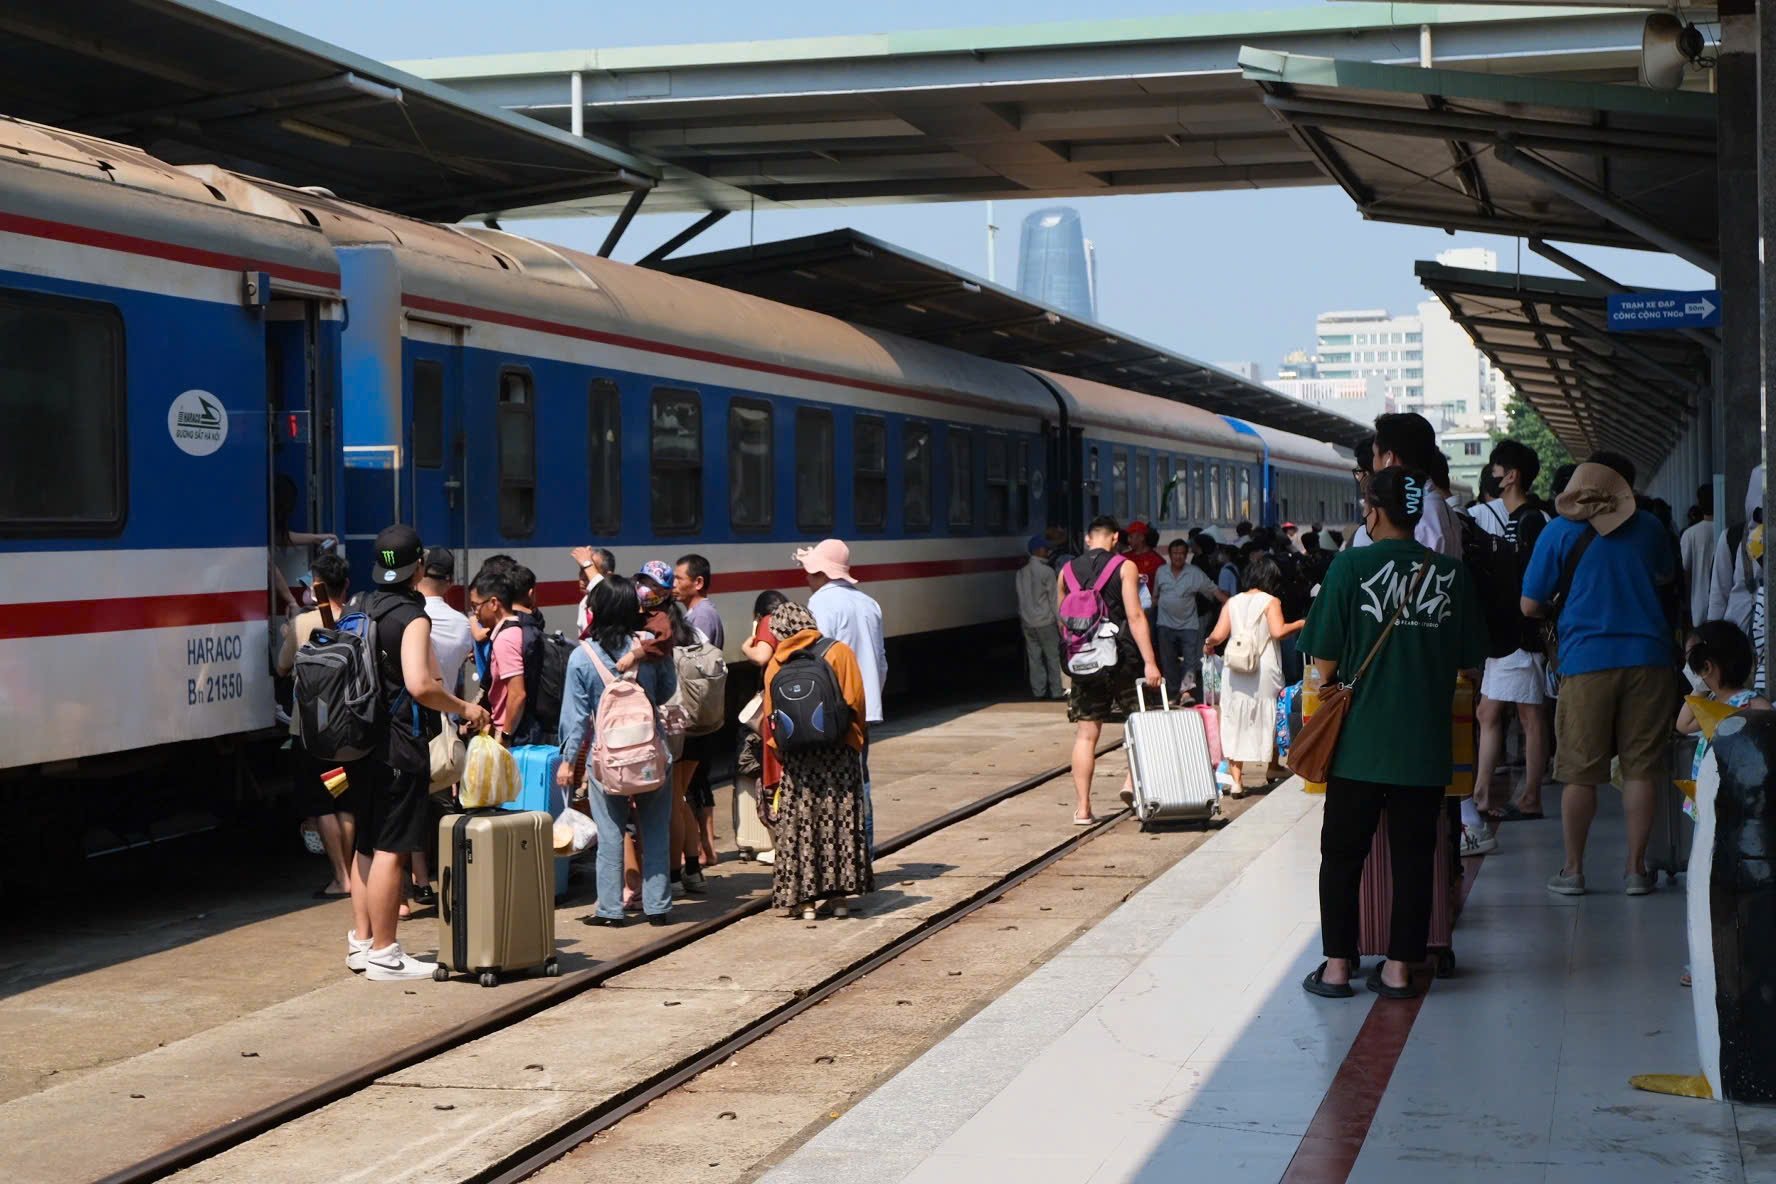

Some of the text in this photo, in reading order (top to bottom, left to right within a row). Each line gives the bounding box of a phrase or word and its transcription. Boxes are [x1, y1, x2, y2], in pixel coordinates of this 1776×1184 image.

[1646, 301, 1656, 309] XE
[187, 635, 242, 665] HARACO
[207, 672, 242, 703] 21550
